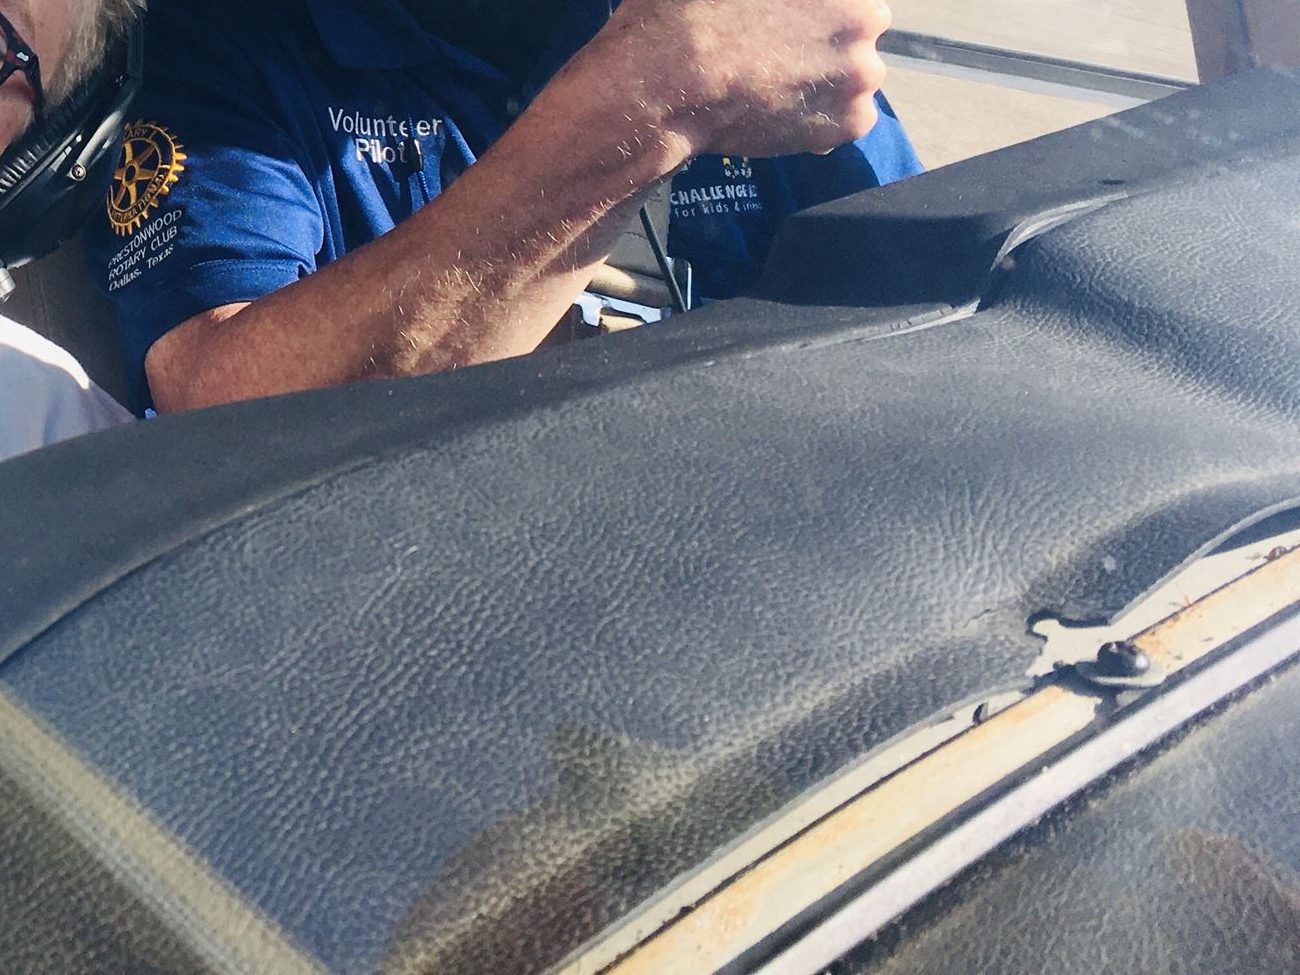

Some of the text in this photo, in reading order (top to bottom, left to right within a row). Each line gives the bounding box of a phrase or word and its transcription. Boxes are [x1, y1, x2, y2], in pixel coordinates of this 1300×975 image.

[327, 106, 443, 138] Volunteer
[674, 207, 696, 218] for
[702, 201, 730, 215] kids
[108, 226, 178, 281] ROTARY CLUB
[146, 243, 174, 269] Texas
